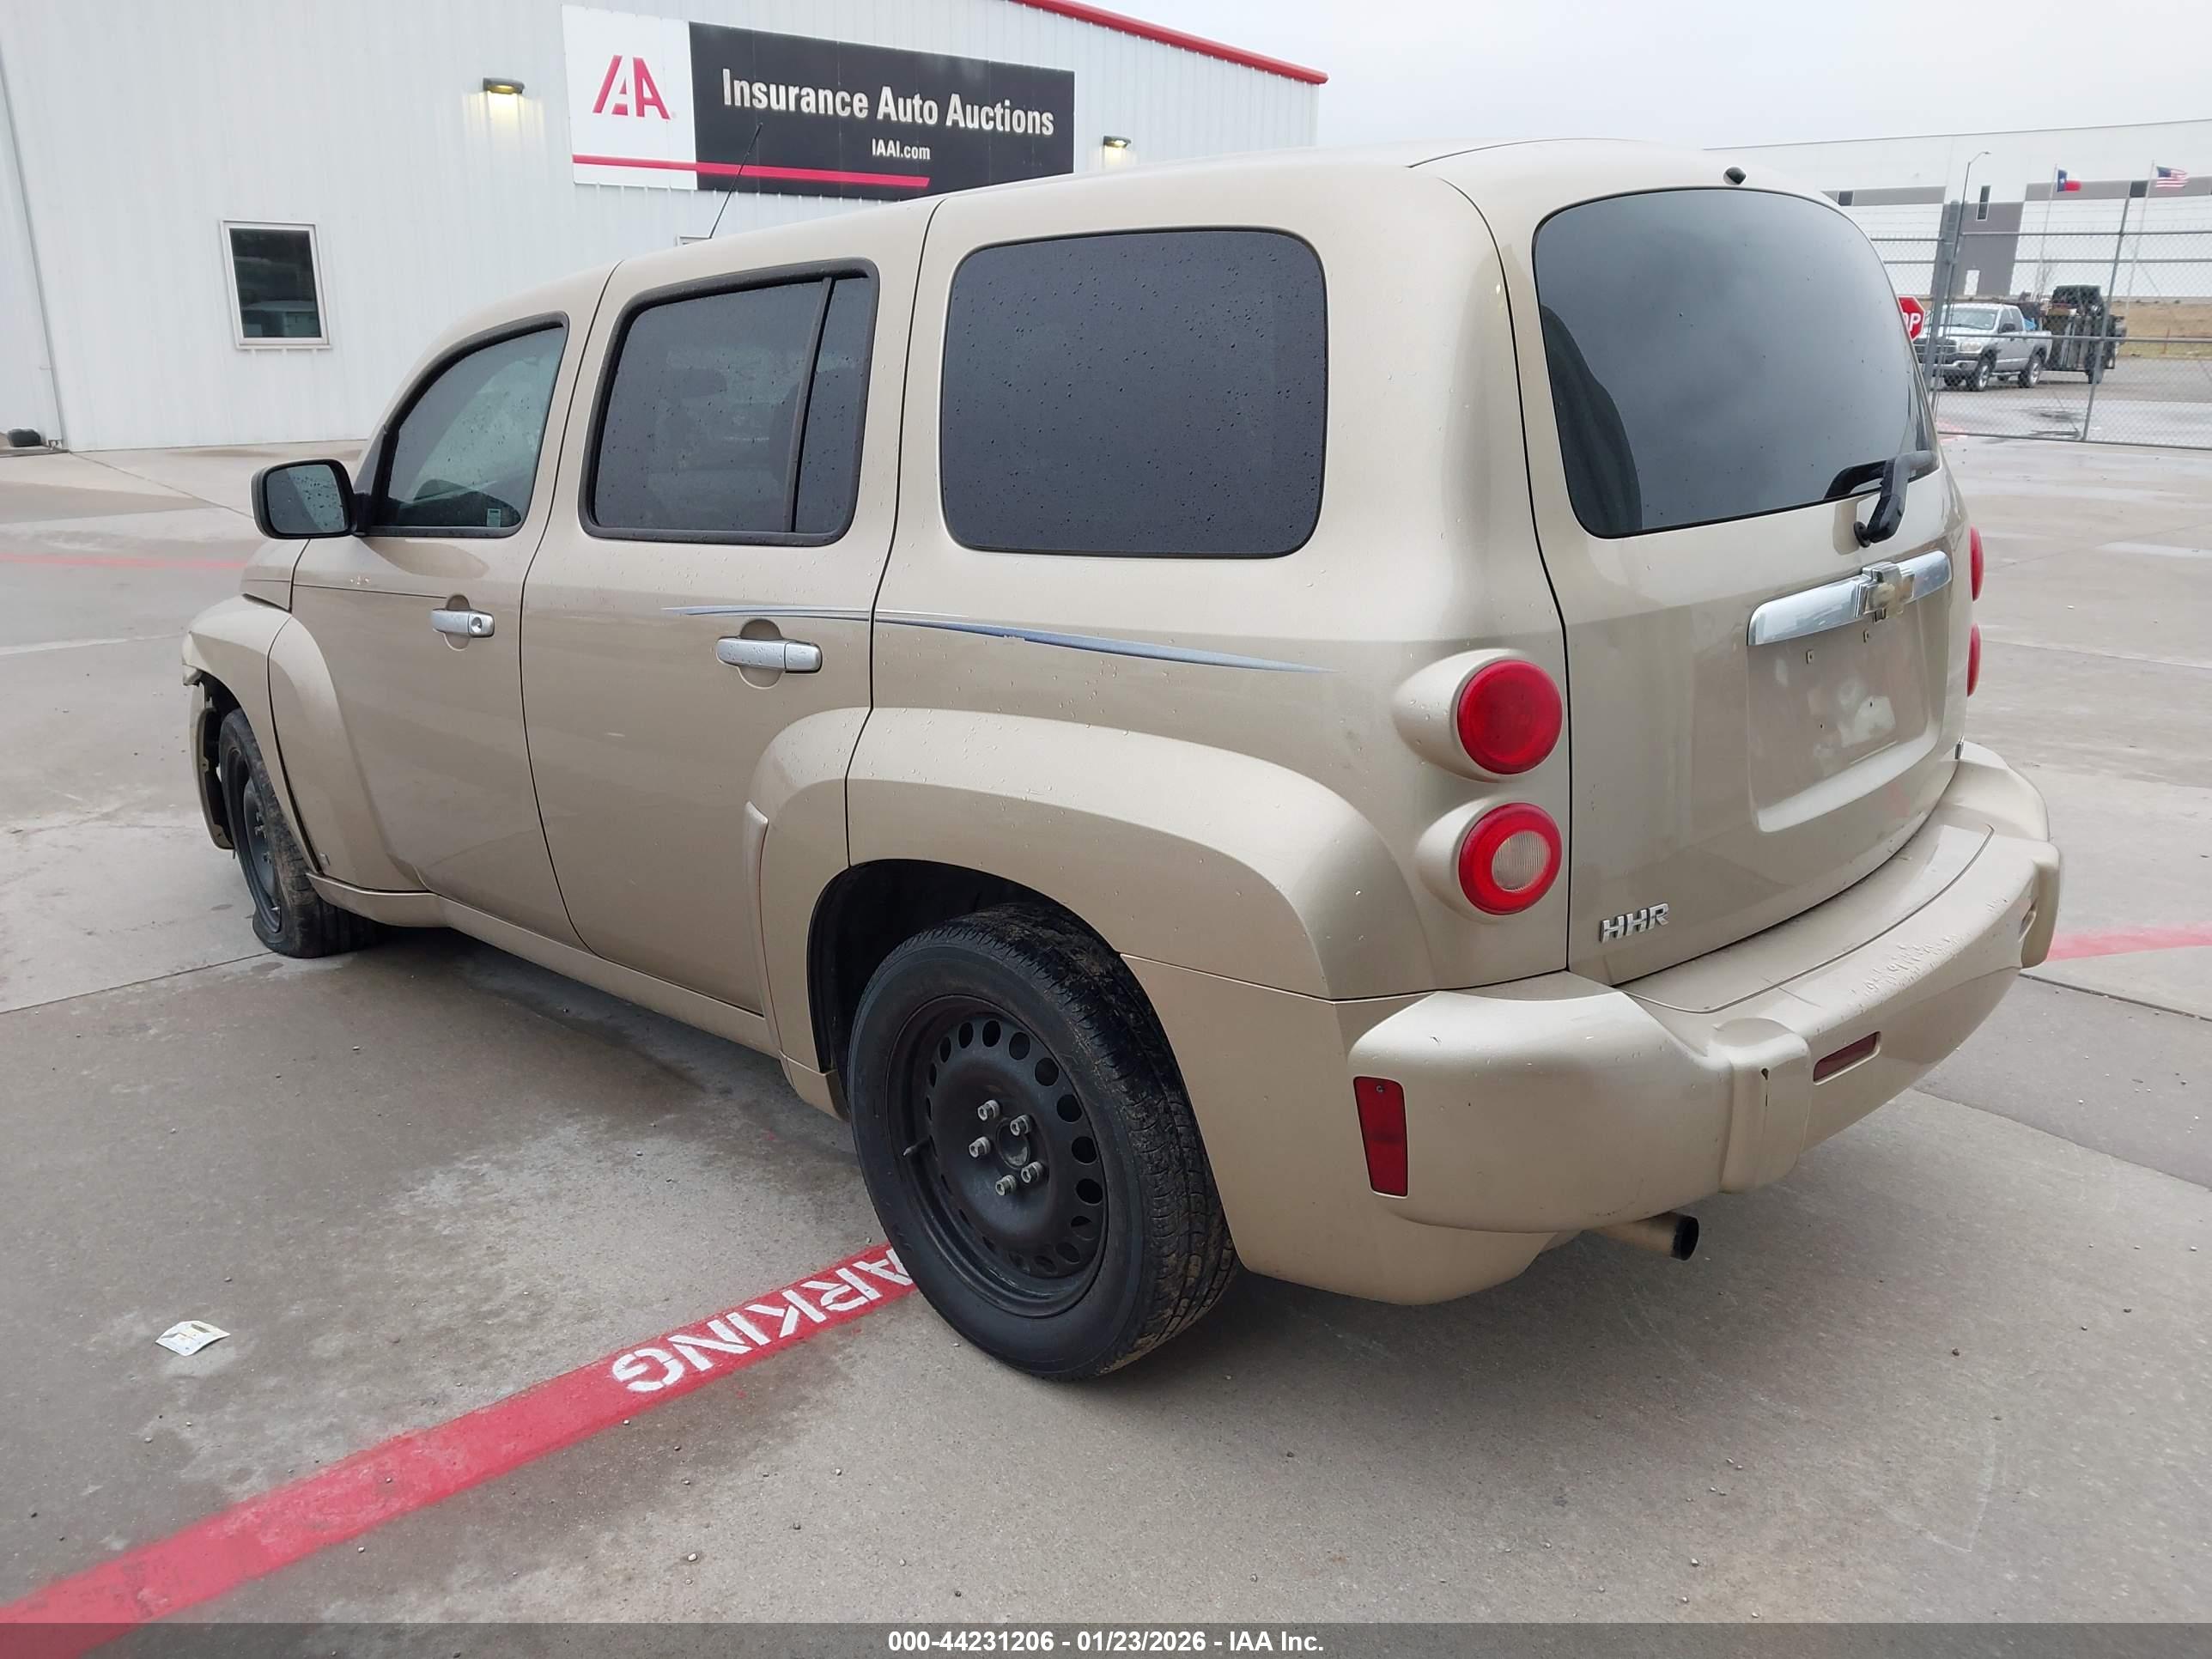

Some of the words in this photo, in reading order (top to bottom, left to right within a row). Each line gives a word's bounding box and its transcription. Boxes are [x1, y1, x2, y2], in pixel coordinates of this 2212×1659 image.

[722, 68, 869, 118] Insurance
[877, 85, 939, 125] Auto
[945, 93, 1055, 136] Auctions
[872, 137, 931, 161] IAAI.com
[1599, 902, 1669, 944] HHR
[611, 1248, 914, 1393] ARKING
